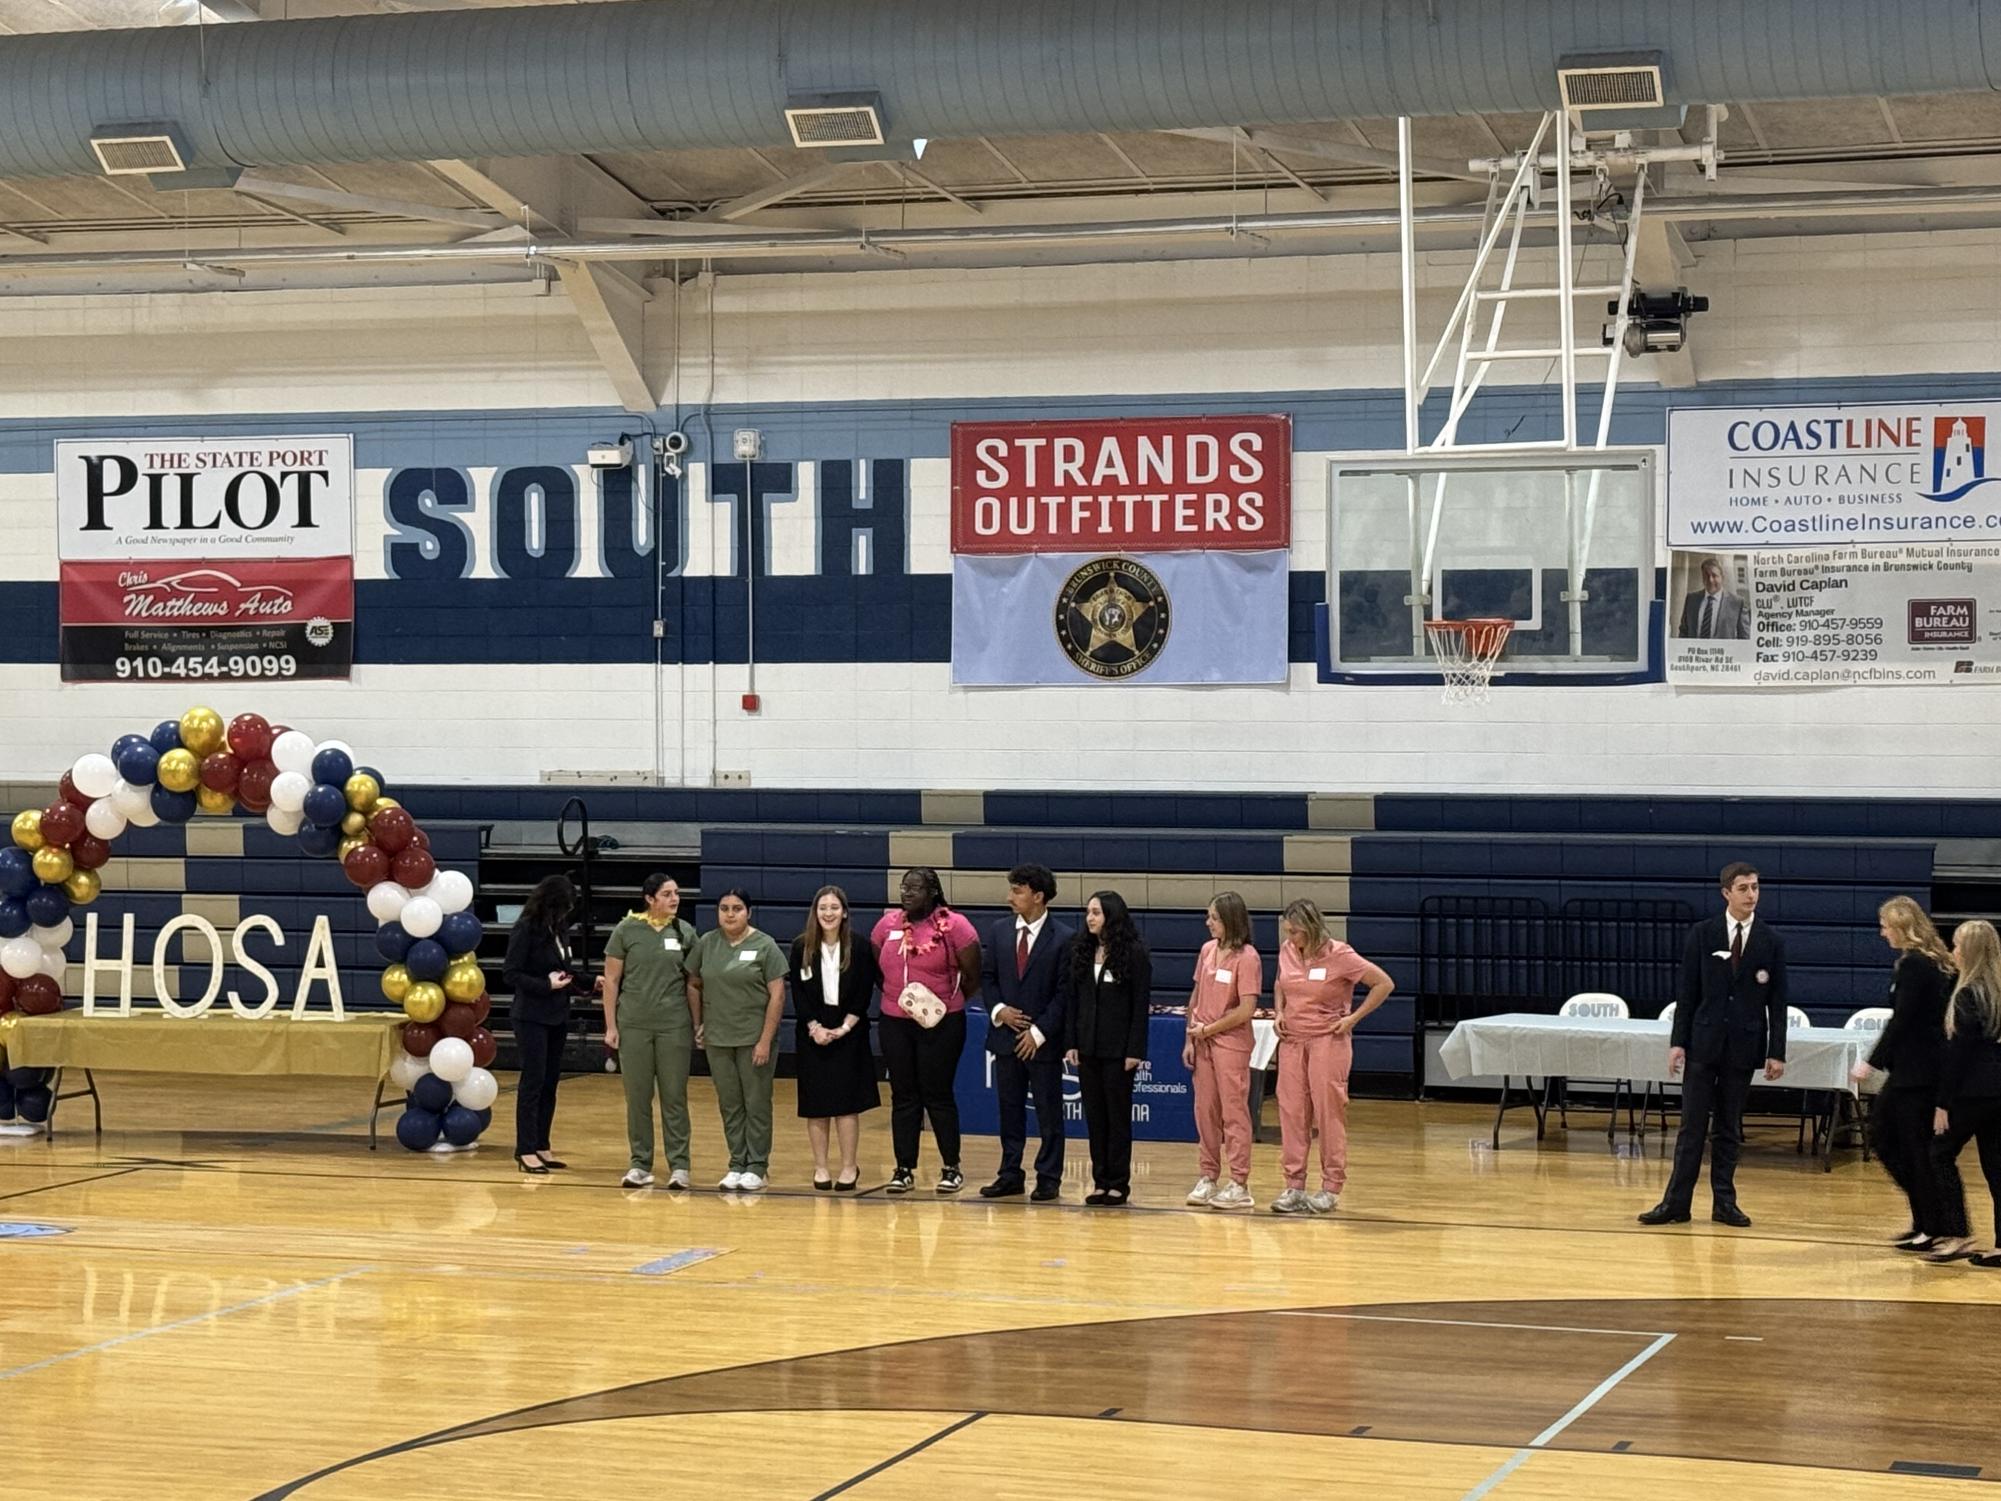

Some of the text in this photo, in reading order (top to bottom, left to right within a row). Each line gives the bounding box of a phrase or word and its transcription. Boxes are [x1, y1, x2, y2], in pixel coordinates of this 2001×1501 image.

[1727, 416, 1922, 452] COASTLINE
[144, 450, 328, 469] THE STATE PORT
[975, 432, 1264, 490] STRANDS
[1728, 463, 1922, 489] INSURANCE
[78, 455, 329, 531] PILOT
[1729, 493, 1903, 507] HOME AUTO BUSINESS
[383, 458, 909, 579] SOUTH
[974, 492, 1264, 536] OUTFITTERS
[1690, 512, 2001, 535] www.CoastlineInsurance.c
[125, 537, 148, 545] Good
[150, 535, 197, 547] Newspaper
[200, 536, 208, 544] in
[218, 535, 242, 544] Good
[244, 534, 295, 545] Community
[1754, 554, 1784, 566] North
[1787, 552, 1830, 564] Carolina
[1832, 550, 1858, 561] Farm
[1906, 547, 1944, 559] Mutual
[1946, 546, 2000, 558] Insurance
[1066, 560, 1160, 594] BRUNSWICK COUNTY
[1754, 567, 1778, 578] Farm
[1821, 563, 1869, 574] Insurance
[1872, 563, 1881, 573] in
[1883, 562, 1934, 573] Brunswick
[1936, 560, 1973, 573] County
[118, 570, 149, 588] Chris
[1755, 577, 1849, 594] David Caplan
[123, 592, 293, 618] Matthews Auto
[1787, 596, 1815, 609] LUTCF
[1930, 605, 1969, 616] FARM
[1757, 608, 1836, 620] Agency Manager
[1914, 616, 1970, 628] BUREAU
[1757, 617, 1884, 633] Office: 910-457-9559
[1756, 633, 1883, 648] Cell: 919-895-8056
[1782, 648, 1878, 663] 910-457-9239
[115, 654, 297, 678] 910-454-9099
[83, 912, 346, 1021] HOSA
[1568, 1003, 1620, 1018] SOUTH
